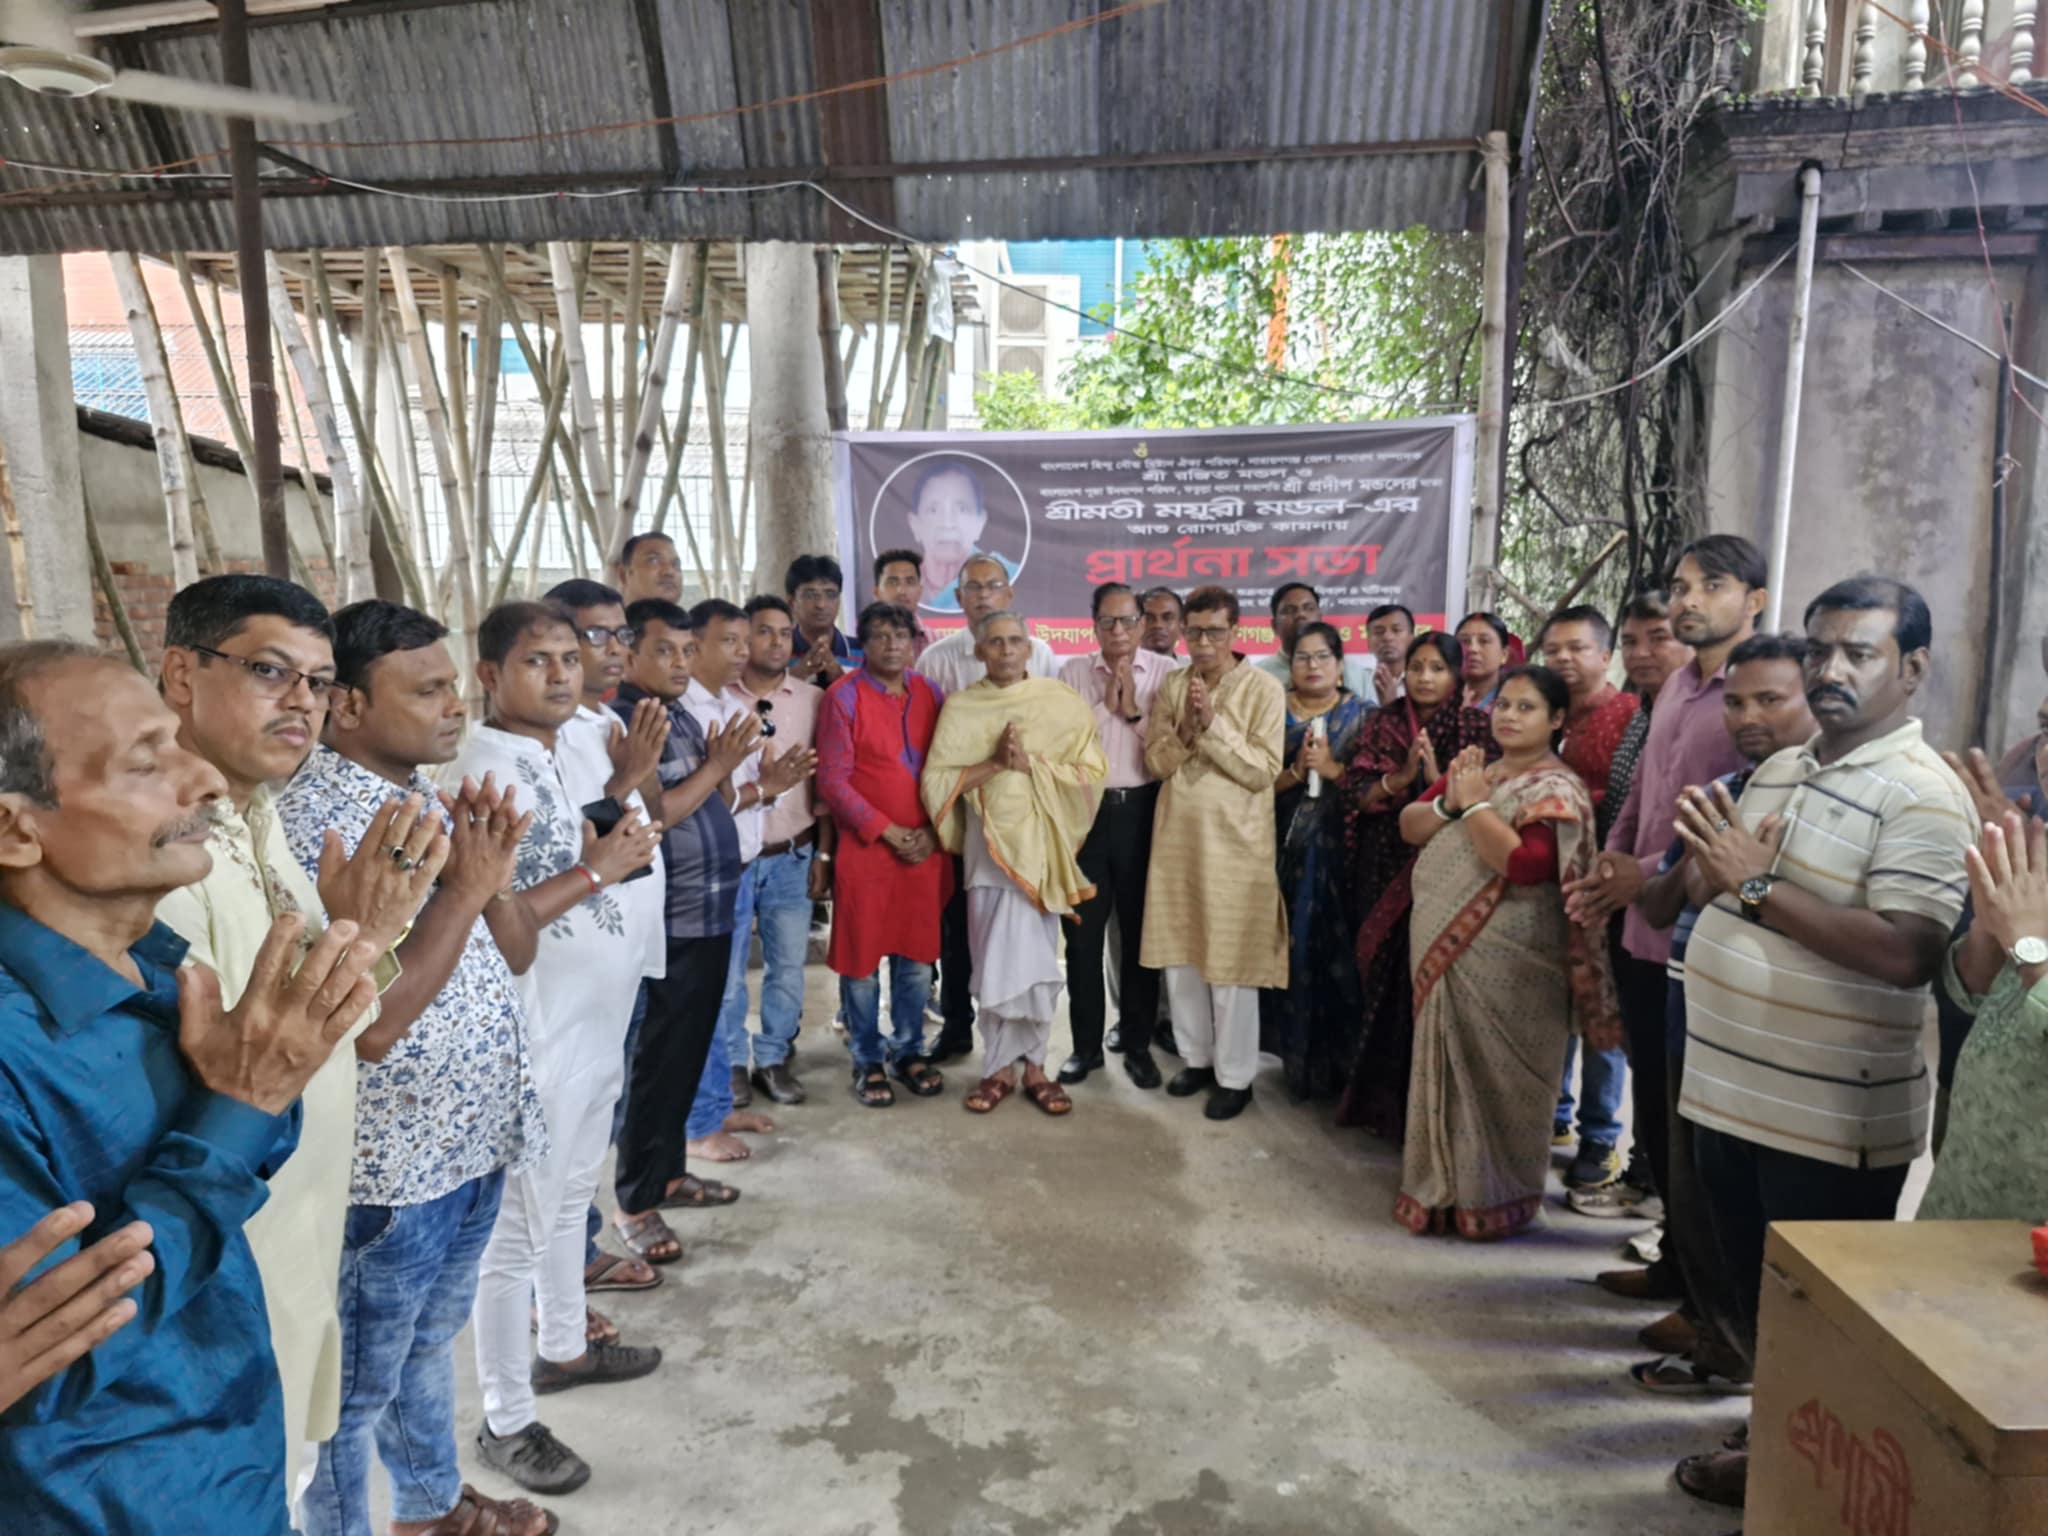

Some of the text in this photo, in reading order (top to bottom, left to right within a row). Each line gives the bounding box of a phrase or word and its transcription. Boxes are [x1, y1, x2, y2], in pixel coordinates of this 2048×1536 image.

[1044, 497, 1145, 520] শ্রীমতী
[1085, 534, 1383, 585] প্রার্থনা সভা
[1035, 623, 1098, 645] উদযাপ
